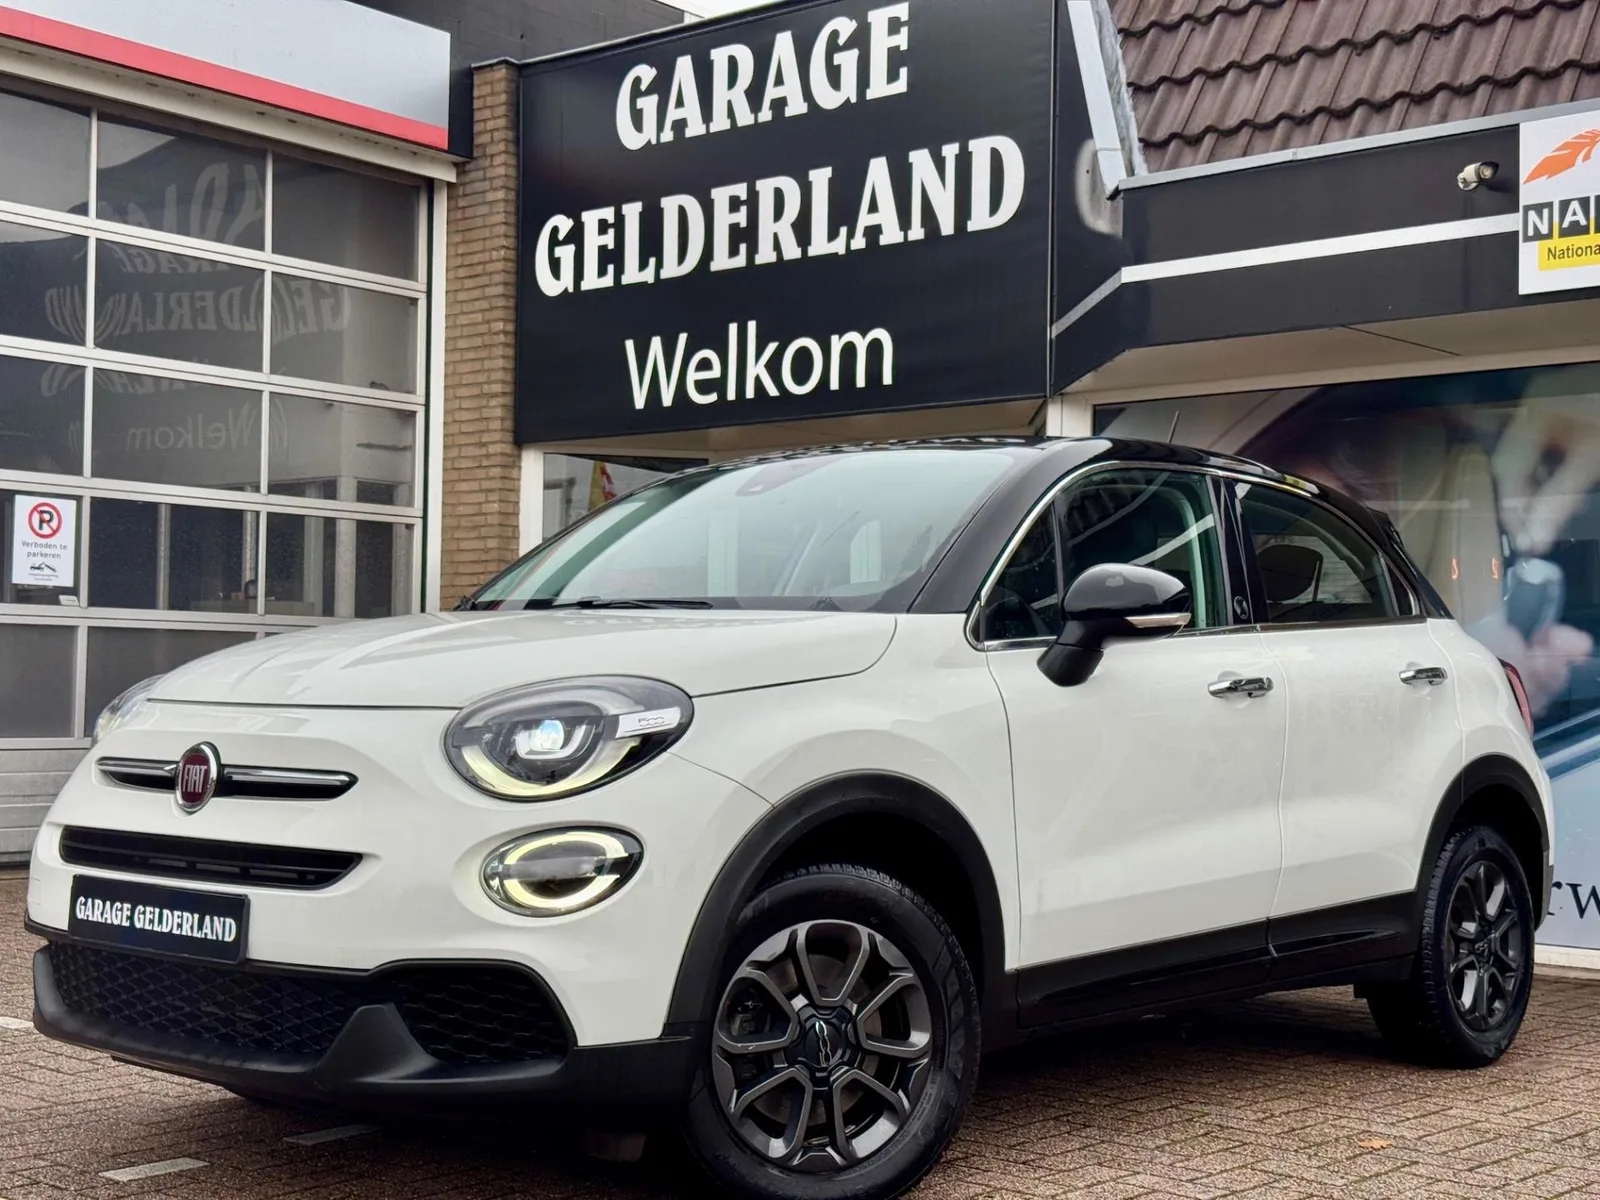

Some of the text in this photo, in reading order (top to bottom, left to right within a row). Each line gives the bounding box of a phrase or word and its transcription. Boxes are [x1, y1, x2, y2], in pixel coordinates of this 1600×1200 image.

[615, 2, 910, 151] GARAGE
[534, 135, 1026, 298] GELDERLAND
[1527, 200, 1588, 237] NA
[624, 319, 894, 411] Welkom
[22, 541, 57, 549] Verboden
[27, 551, 61, 559] parkeren
[182, 764, 208, 793] FIAT
[75, 895, 237, 943] GARAGE GELDERLAND
